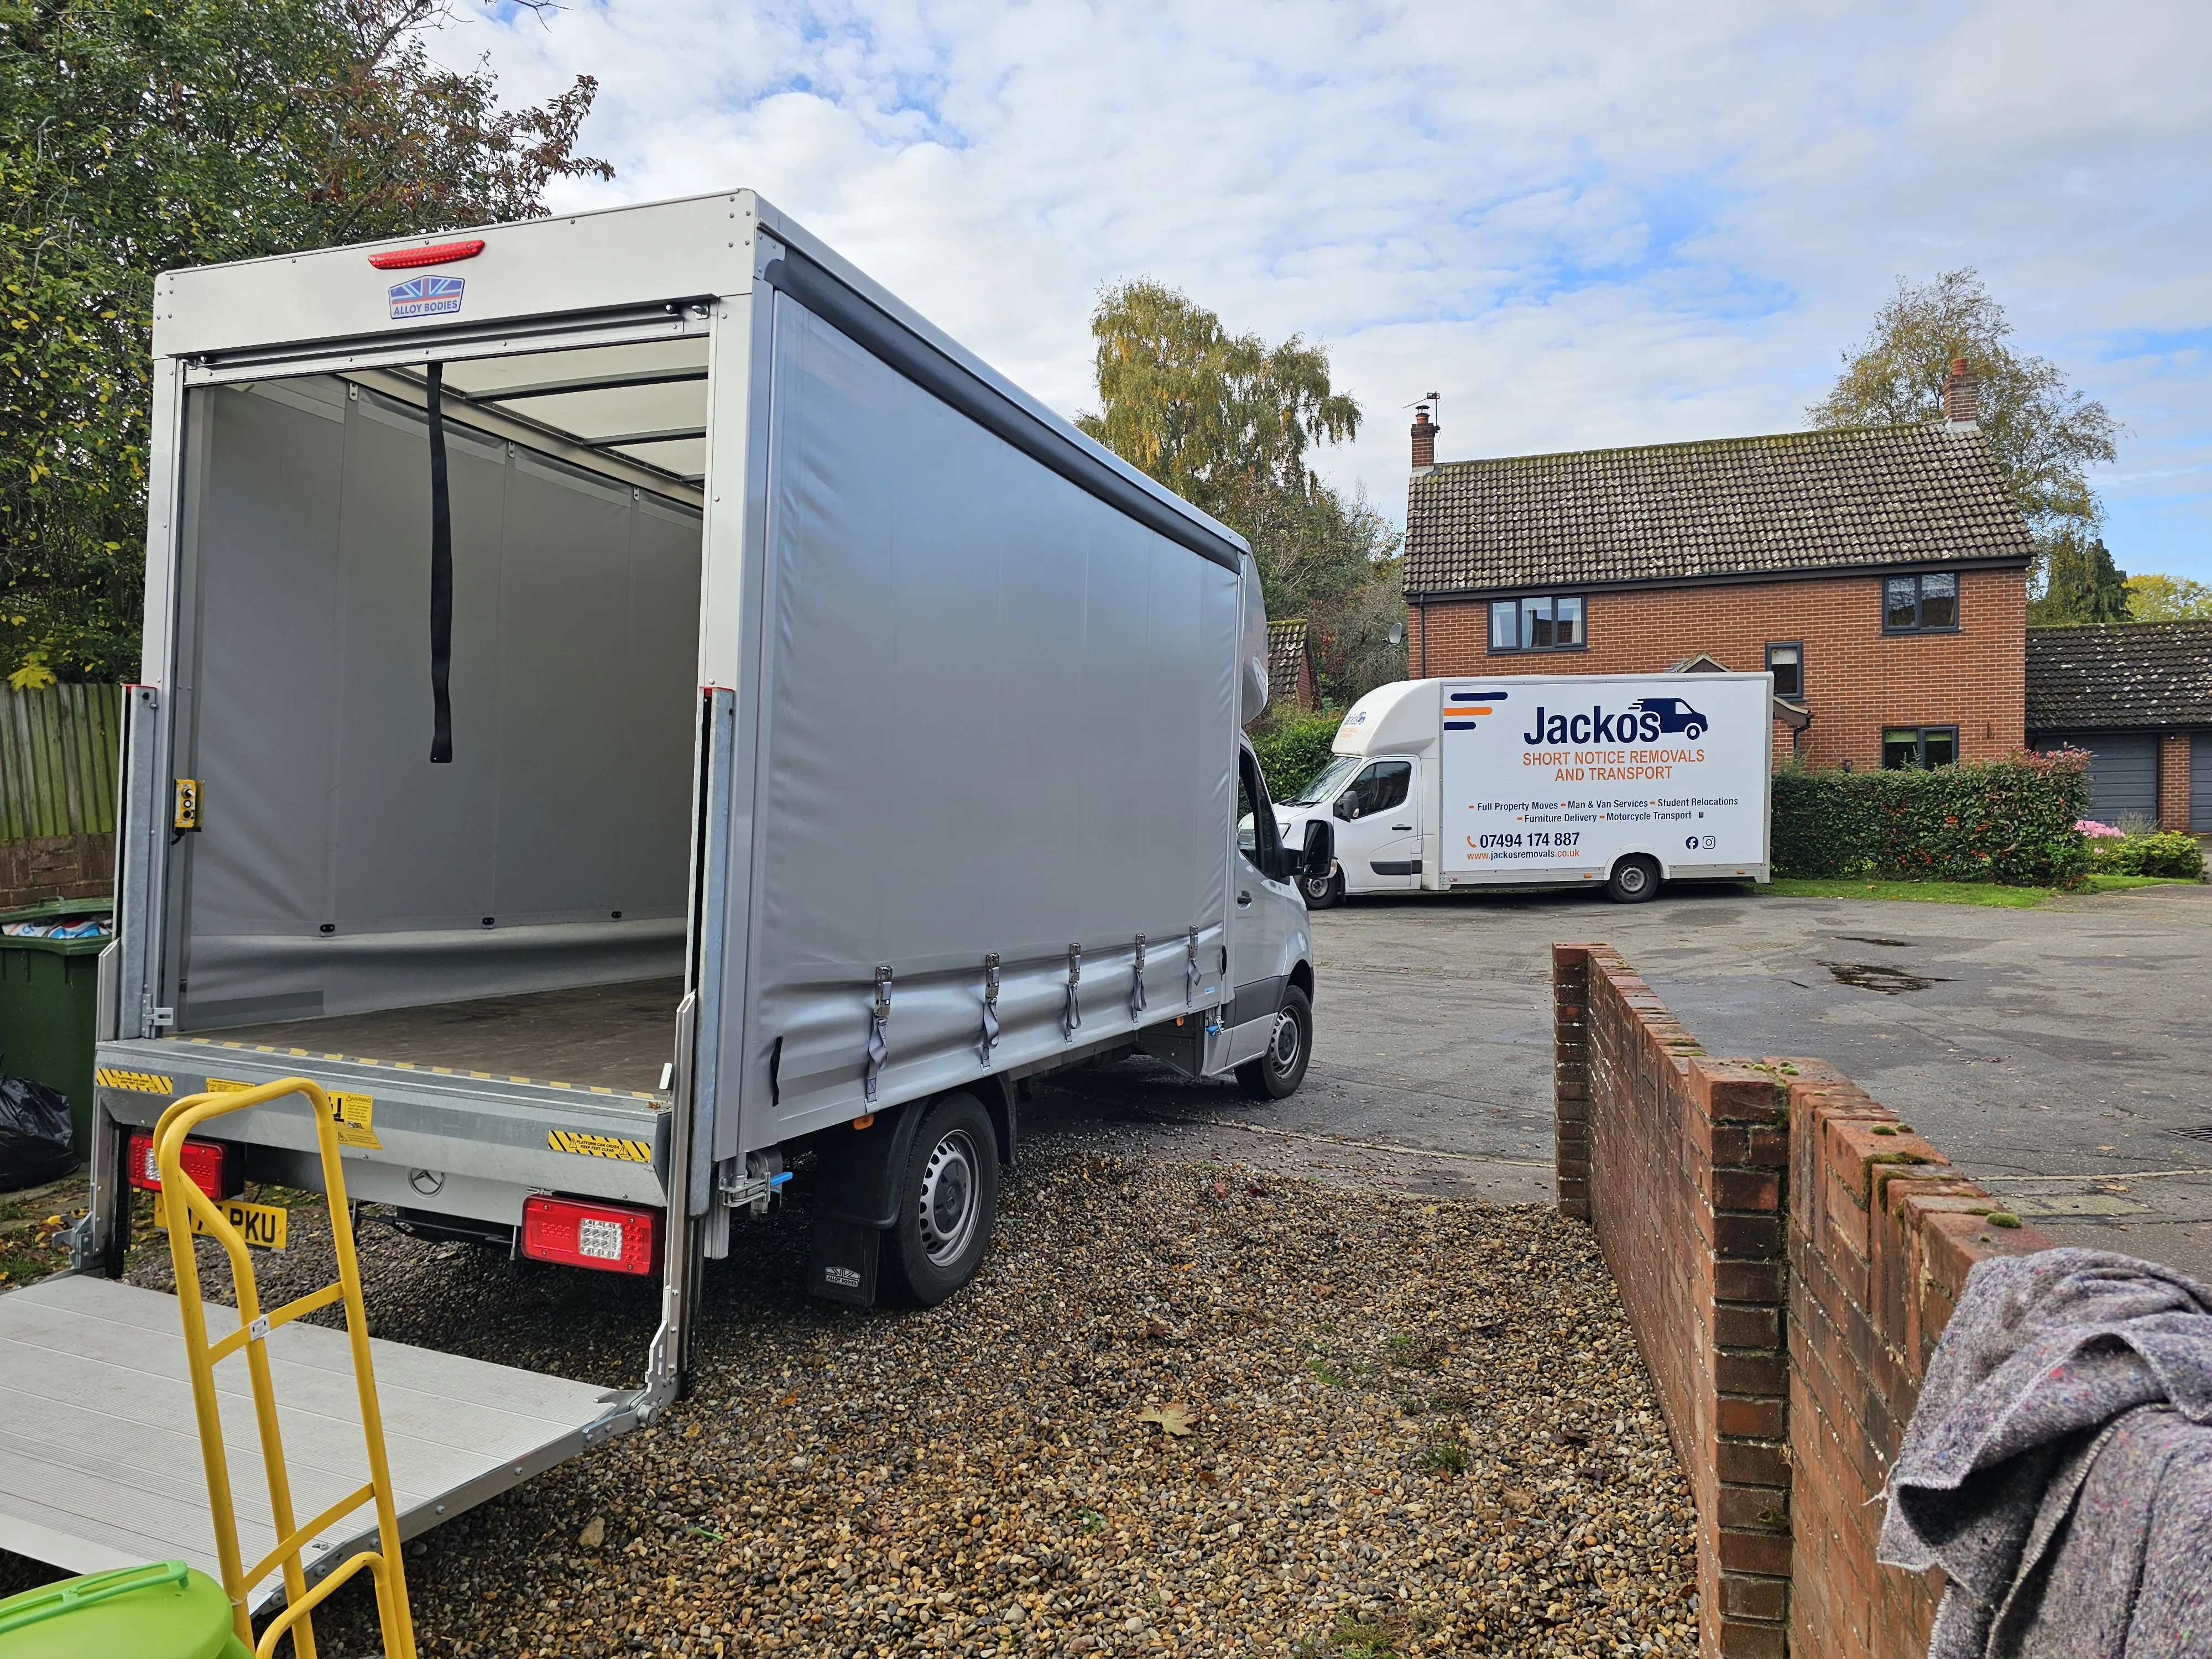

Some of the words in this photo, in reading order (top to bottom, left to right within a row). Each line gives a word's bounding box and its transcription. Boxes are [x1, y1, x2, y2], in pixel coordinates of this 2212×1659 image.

[393, 304, 422, 316] ALLOY
[424, 300, 458, 312] BODIES
[1524, 705, 1660, 745] Jackos
[1522, 752, 1571, 766] SHORT
[1575, 751, 1625, 764] NOTICE
[1630, 749, 1705, 763] REMOVALS
[1555, 768, 1584, 781] AND
[1589, 766, 1673, 781] TRANSPORT
[1478, 802, 1492, 811] Full
[1495, 802, 1529, 812] Property
[1532, 801, 1558, 810] Moves
[1568, 801, 1585, 809] Man
[1597, 800, 1611, 808] Van
[1614, 799, 1648, 808] Services
[1657, 798, 1689, 807] Student
[1691, 797, 1738, 806] Relocations
[1525, 814, 1562, 823] Furniture
[1564, 813, 1597, 823] Delivery
[1606, 812, 1651, 821] Motorcycle
[1653, 811, 1692, 821] Transport
[1480, 833, 1522, 848] 07494
[1527, 833, 1550, 847] 174
[1554, 832, 1580, 846] 887
[1467, 849, 1580, 861] www.jackosremovals.co.uk
[230, 1207, 276, 1244] PKU
